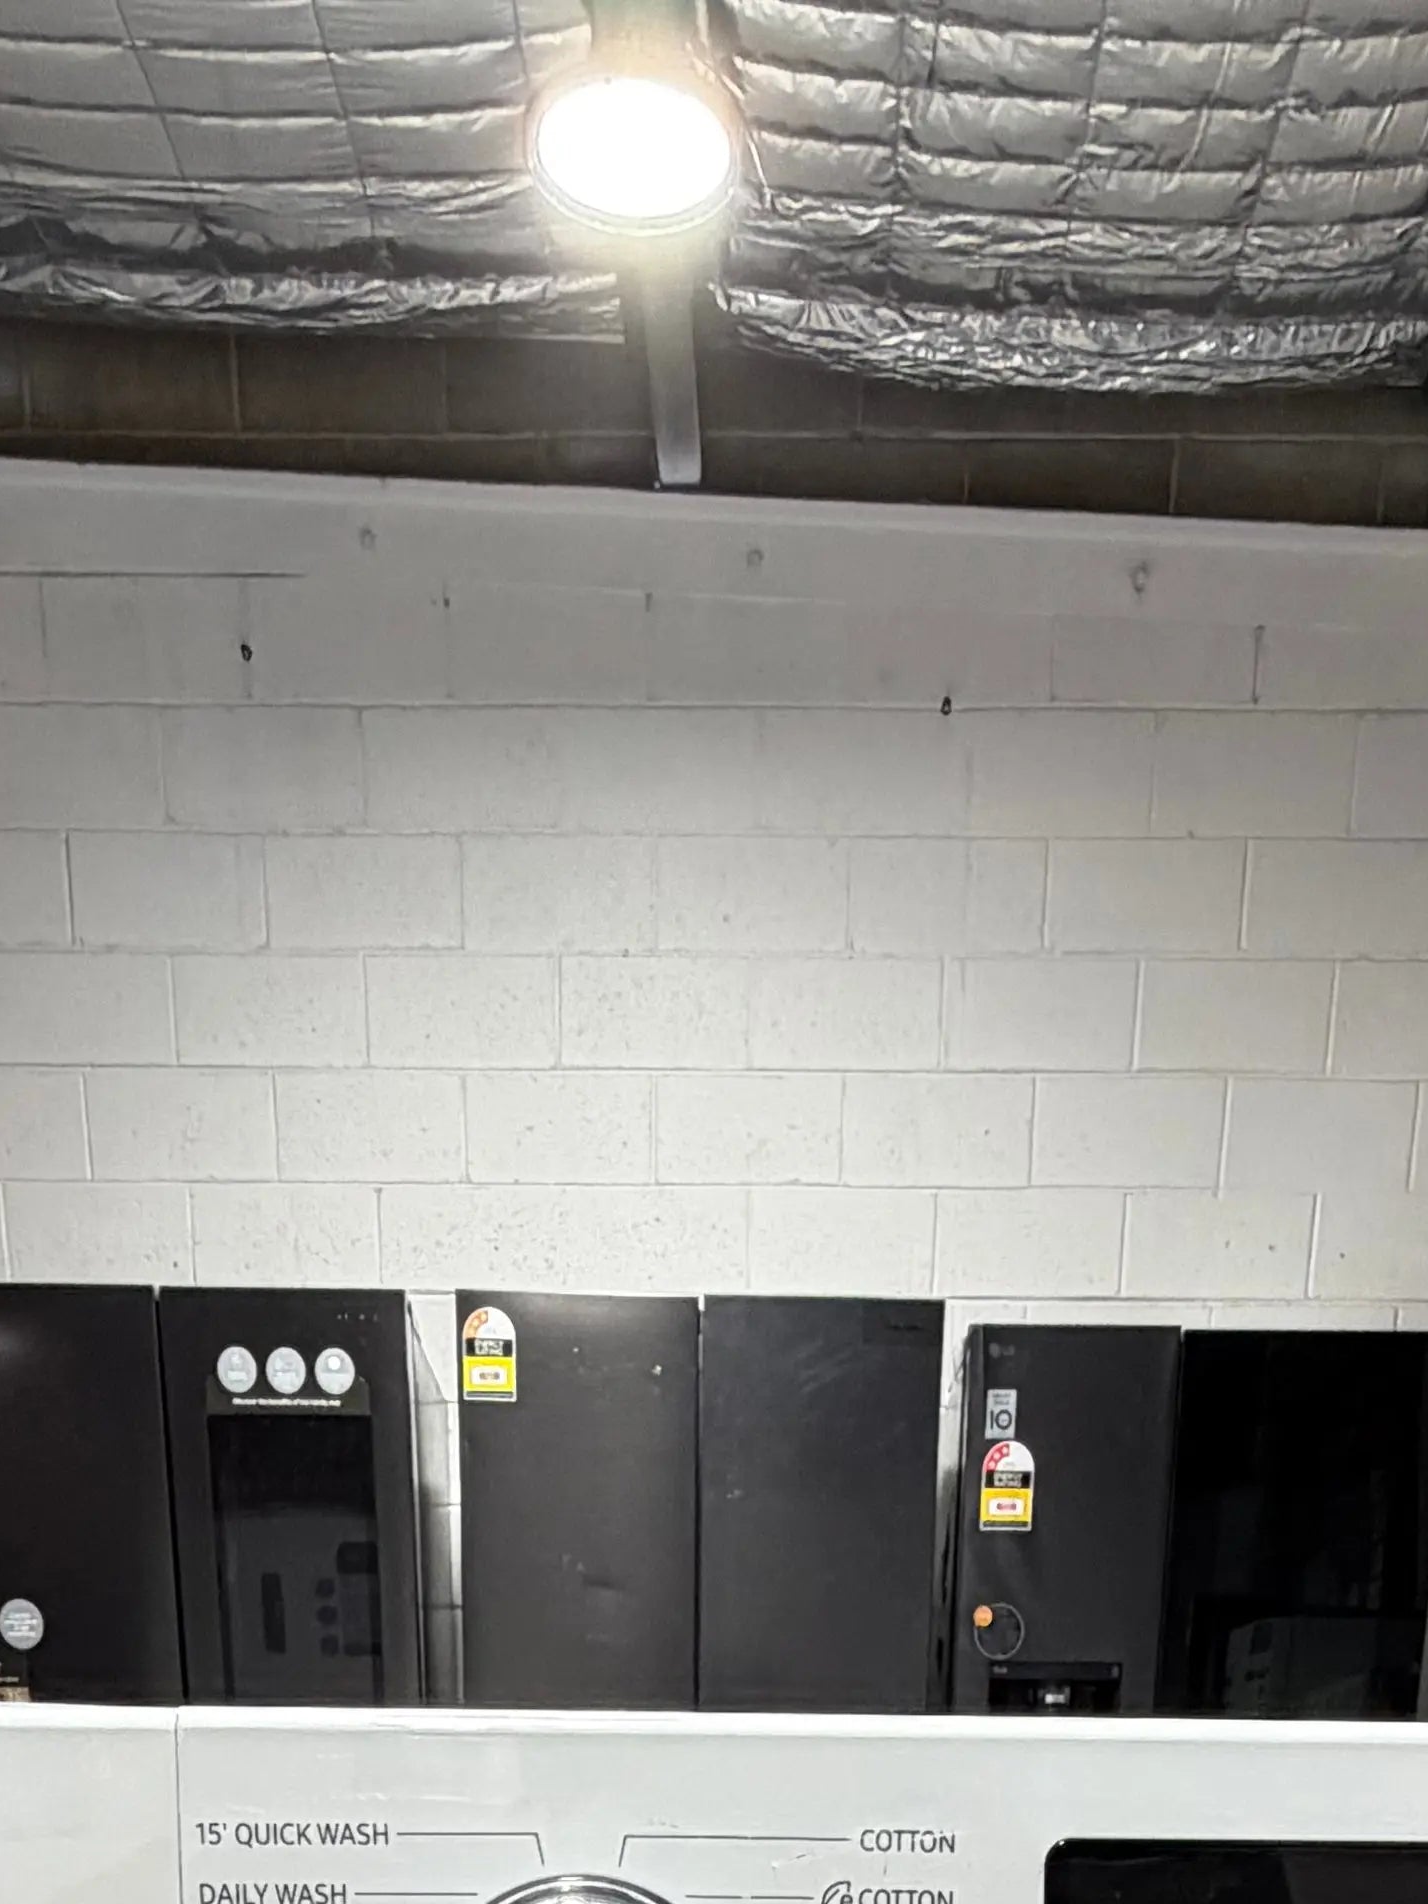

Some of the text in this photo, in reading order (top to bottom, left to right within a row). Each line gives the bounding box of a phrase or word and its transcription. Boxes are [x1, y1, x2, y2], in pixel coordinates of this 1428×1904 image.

[234, 1823, 313, 1848] QUICK
[316, 1823, 390, 1846] WASH
[859, 1829, 956, 1853] COTTON
